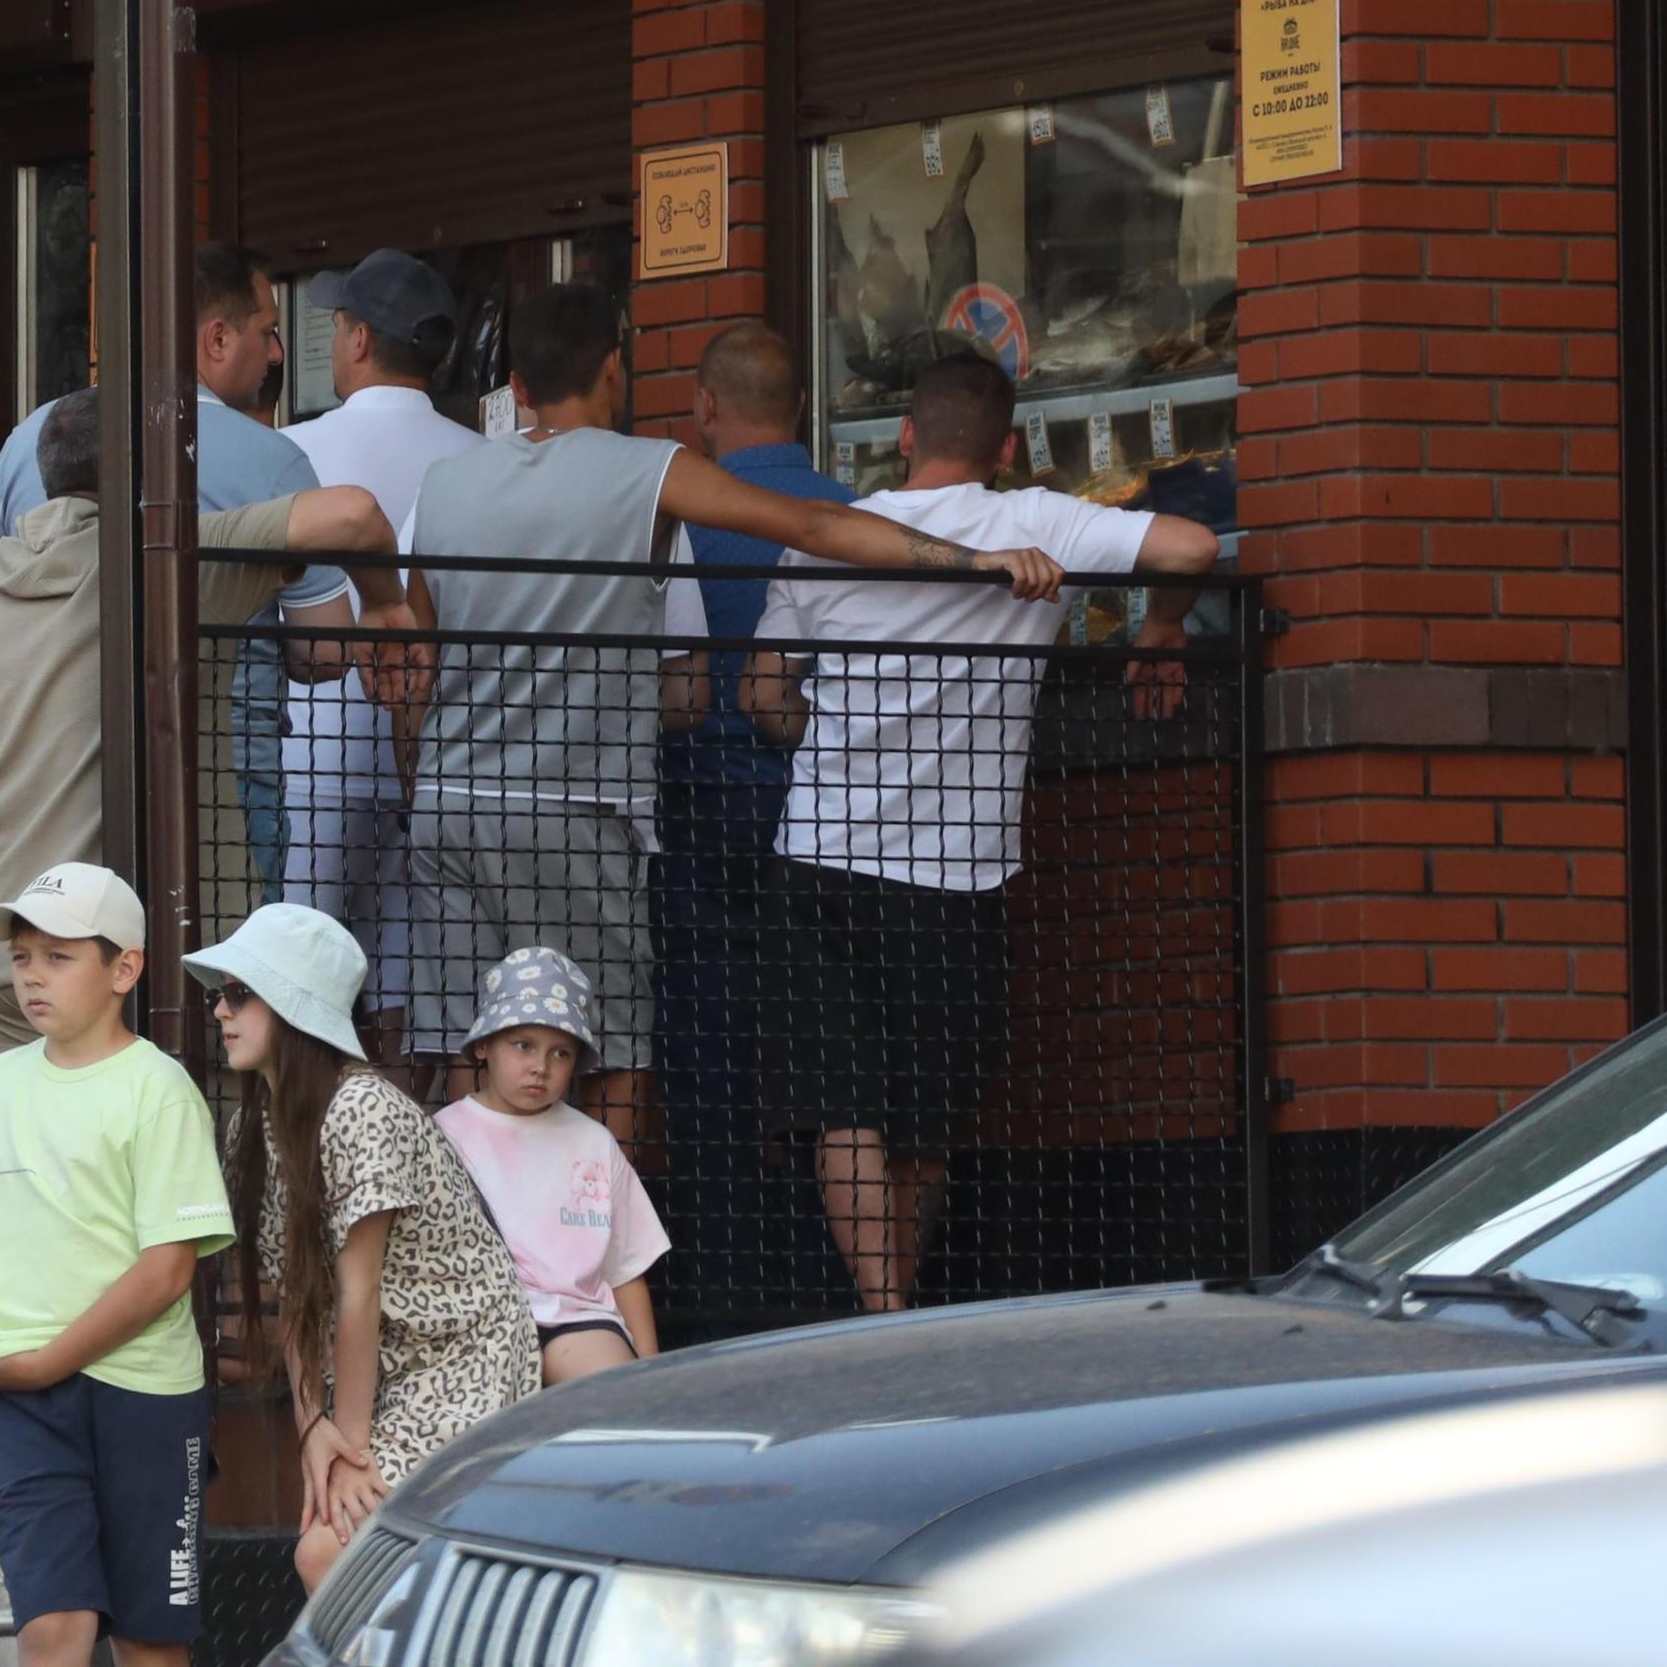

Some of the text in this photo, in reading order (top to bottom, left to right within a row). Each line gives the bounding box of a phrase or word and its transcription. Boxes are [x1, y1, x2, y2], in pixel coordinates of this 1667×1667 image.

[1260, 61, 1321, 82] РЕЖИМ РАБОТЫ
[1273, 81, 1308, 95] ЕЖЕДНЕВНО
[1252, 92, 1329, 116] С 10:00 ДО 22:00
[559, 1206, 612, 1227] CARE BEA
[169, 1549, 189, 1605] A LIFE
